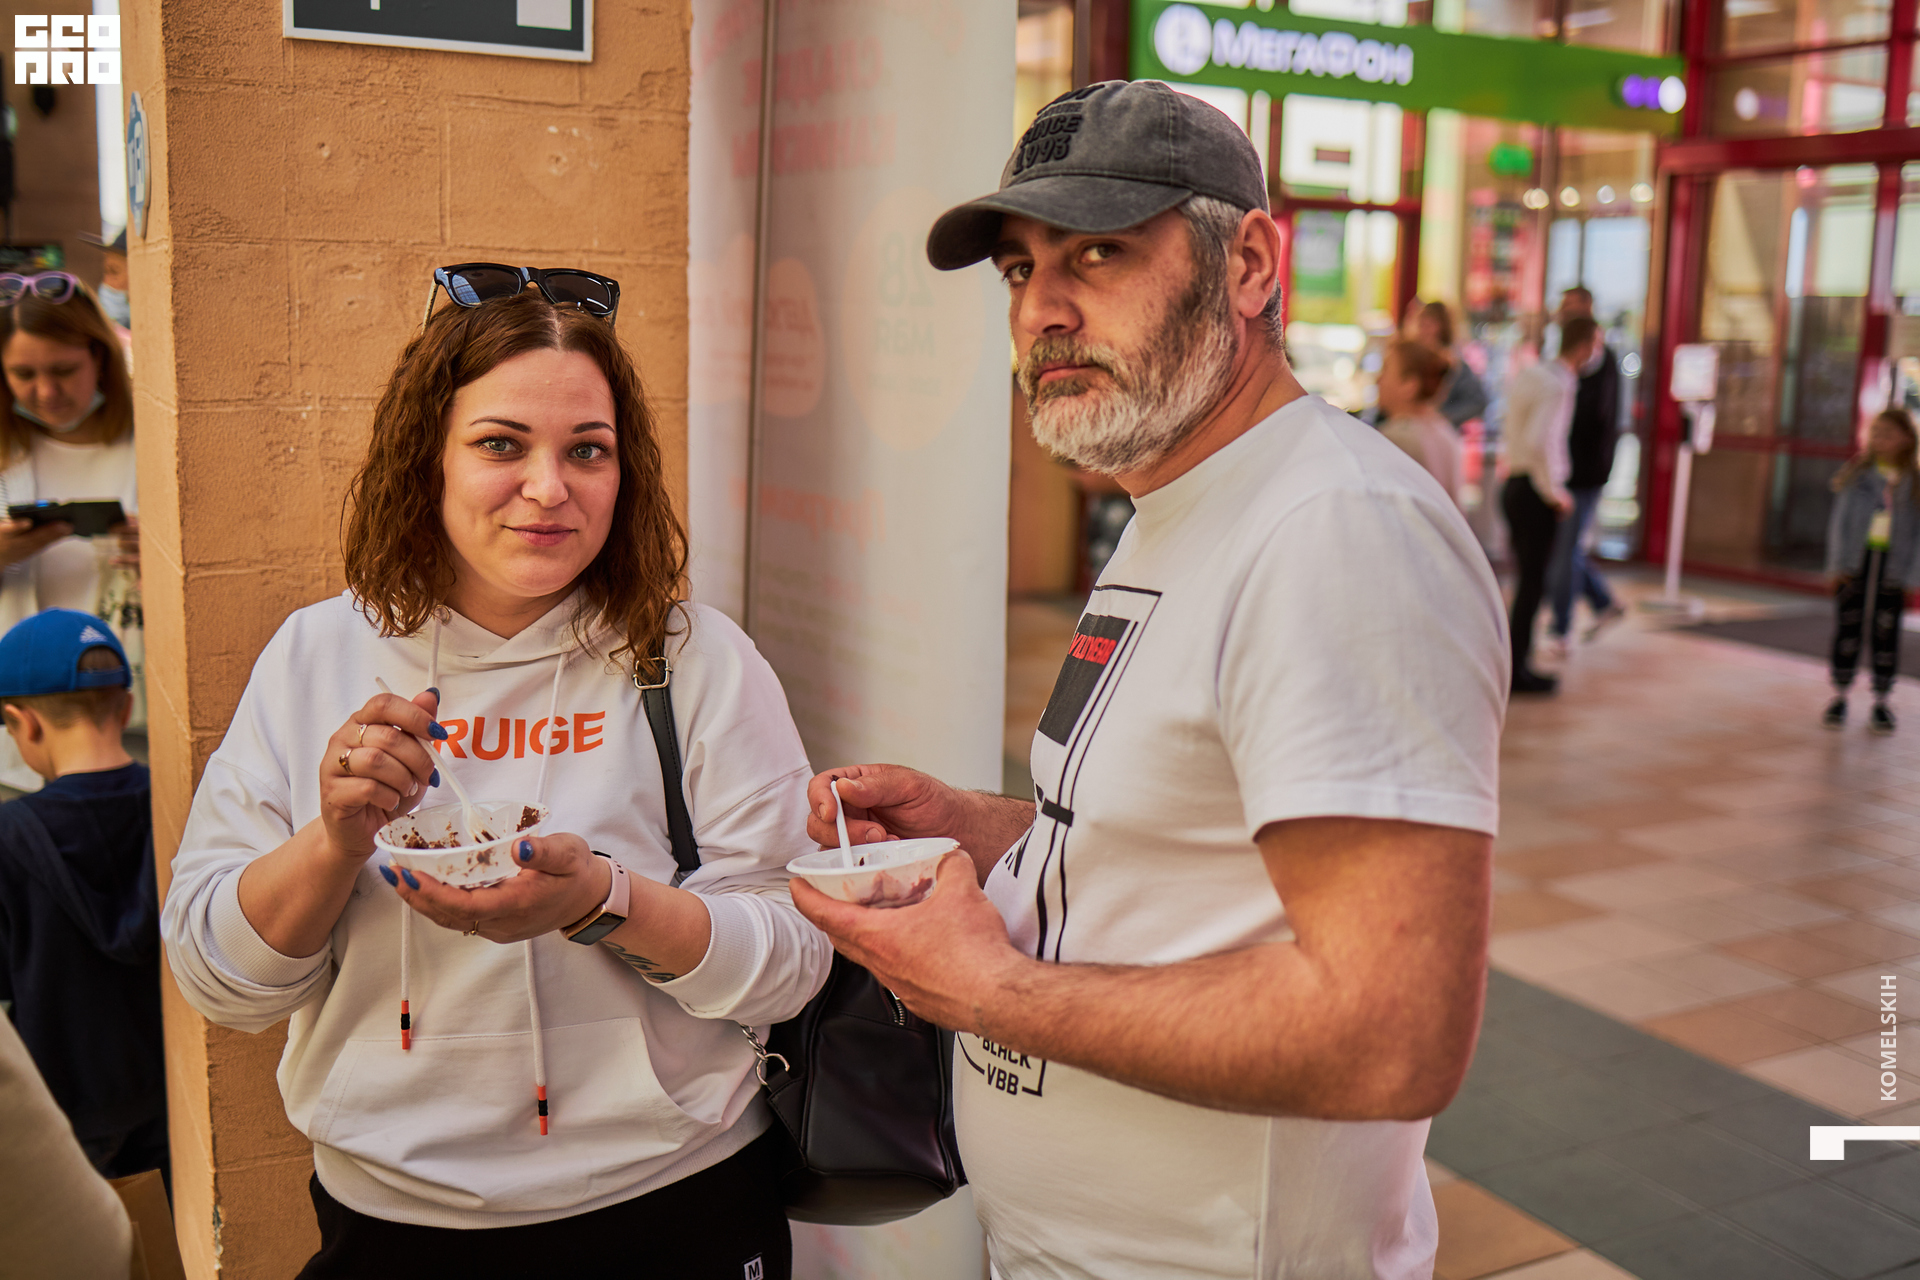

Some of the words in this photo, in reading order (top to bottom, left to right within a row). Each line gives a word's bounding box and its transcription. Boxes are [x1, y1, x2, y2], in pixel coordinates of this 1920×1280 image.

[1020, 114, 1083, 148] SINCE
[1012, 133, 1072, 176] 1993
[982, 1036, 1031, 1070] BLACK
[986, 1062, 1020, 1096] VBB
